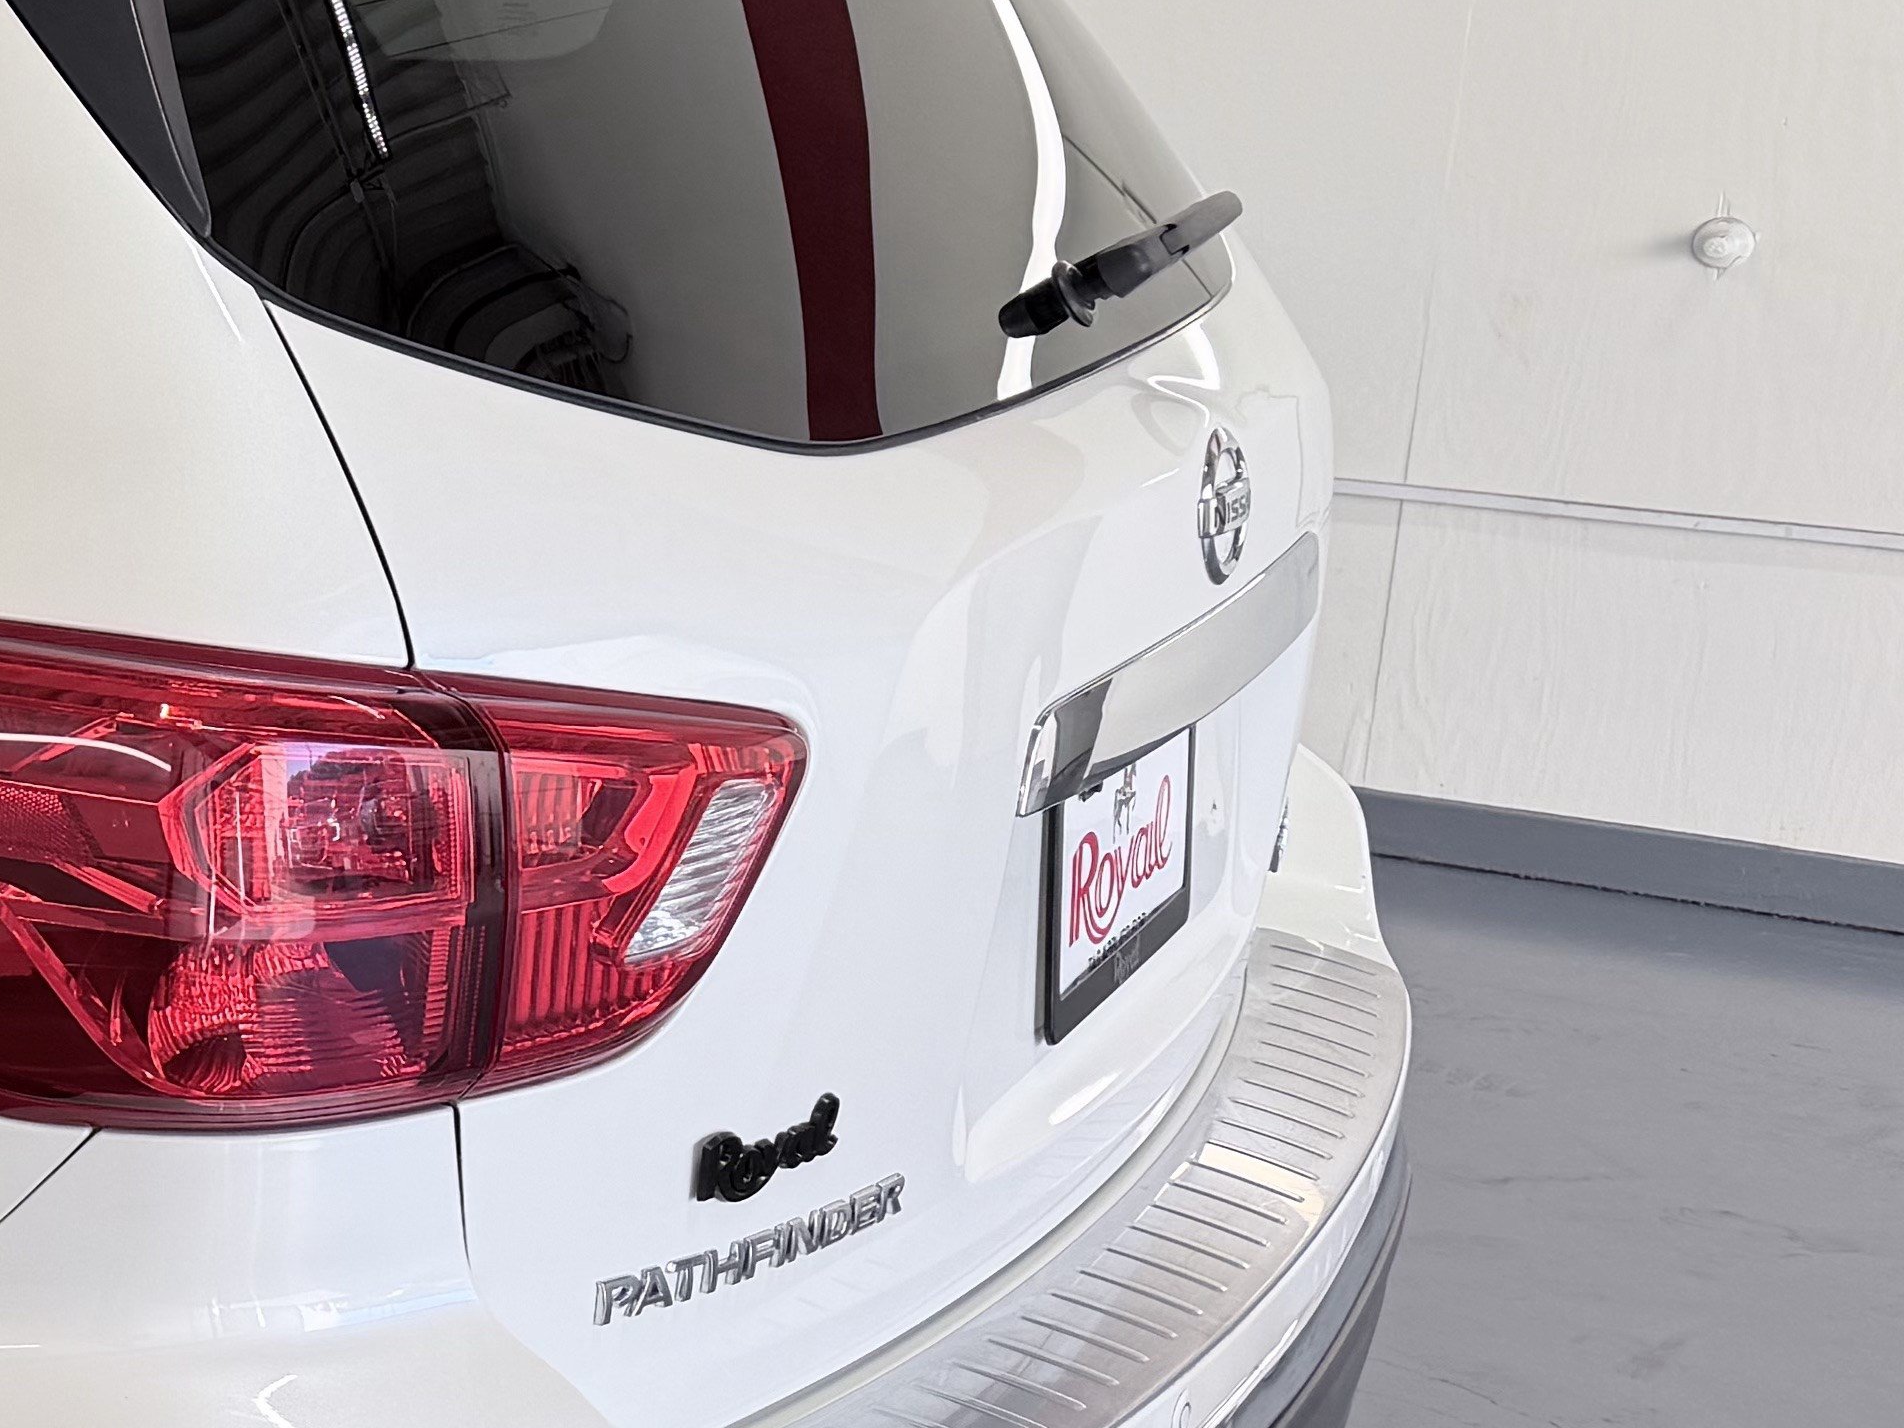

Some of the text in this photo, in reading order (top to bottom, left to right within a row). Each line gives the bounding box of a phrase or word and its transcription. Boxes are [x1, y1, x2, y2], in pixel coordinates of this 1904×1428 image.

[1214, 495, 1249, 529] NISS
[1069, 774, 1173, 948] Royal
[691, 1092, 840, 1203] Royal
[593, 1172, 906, 1326] PATHFINDER
